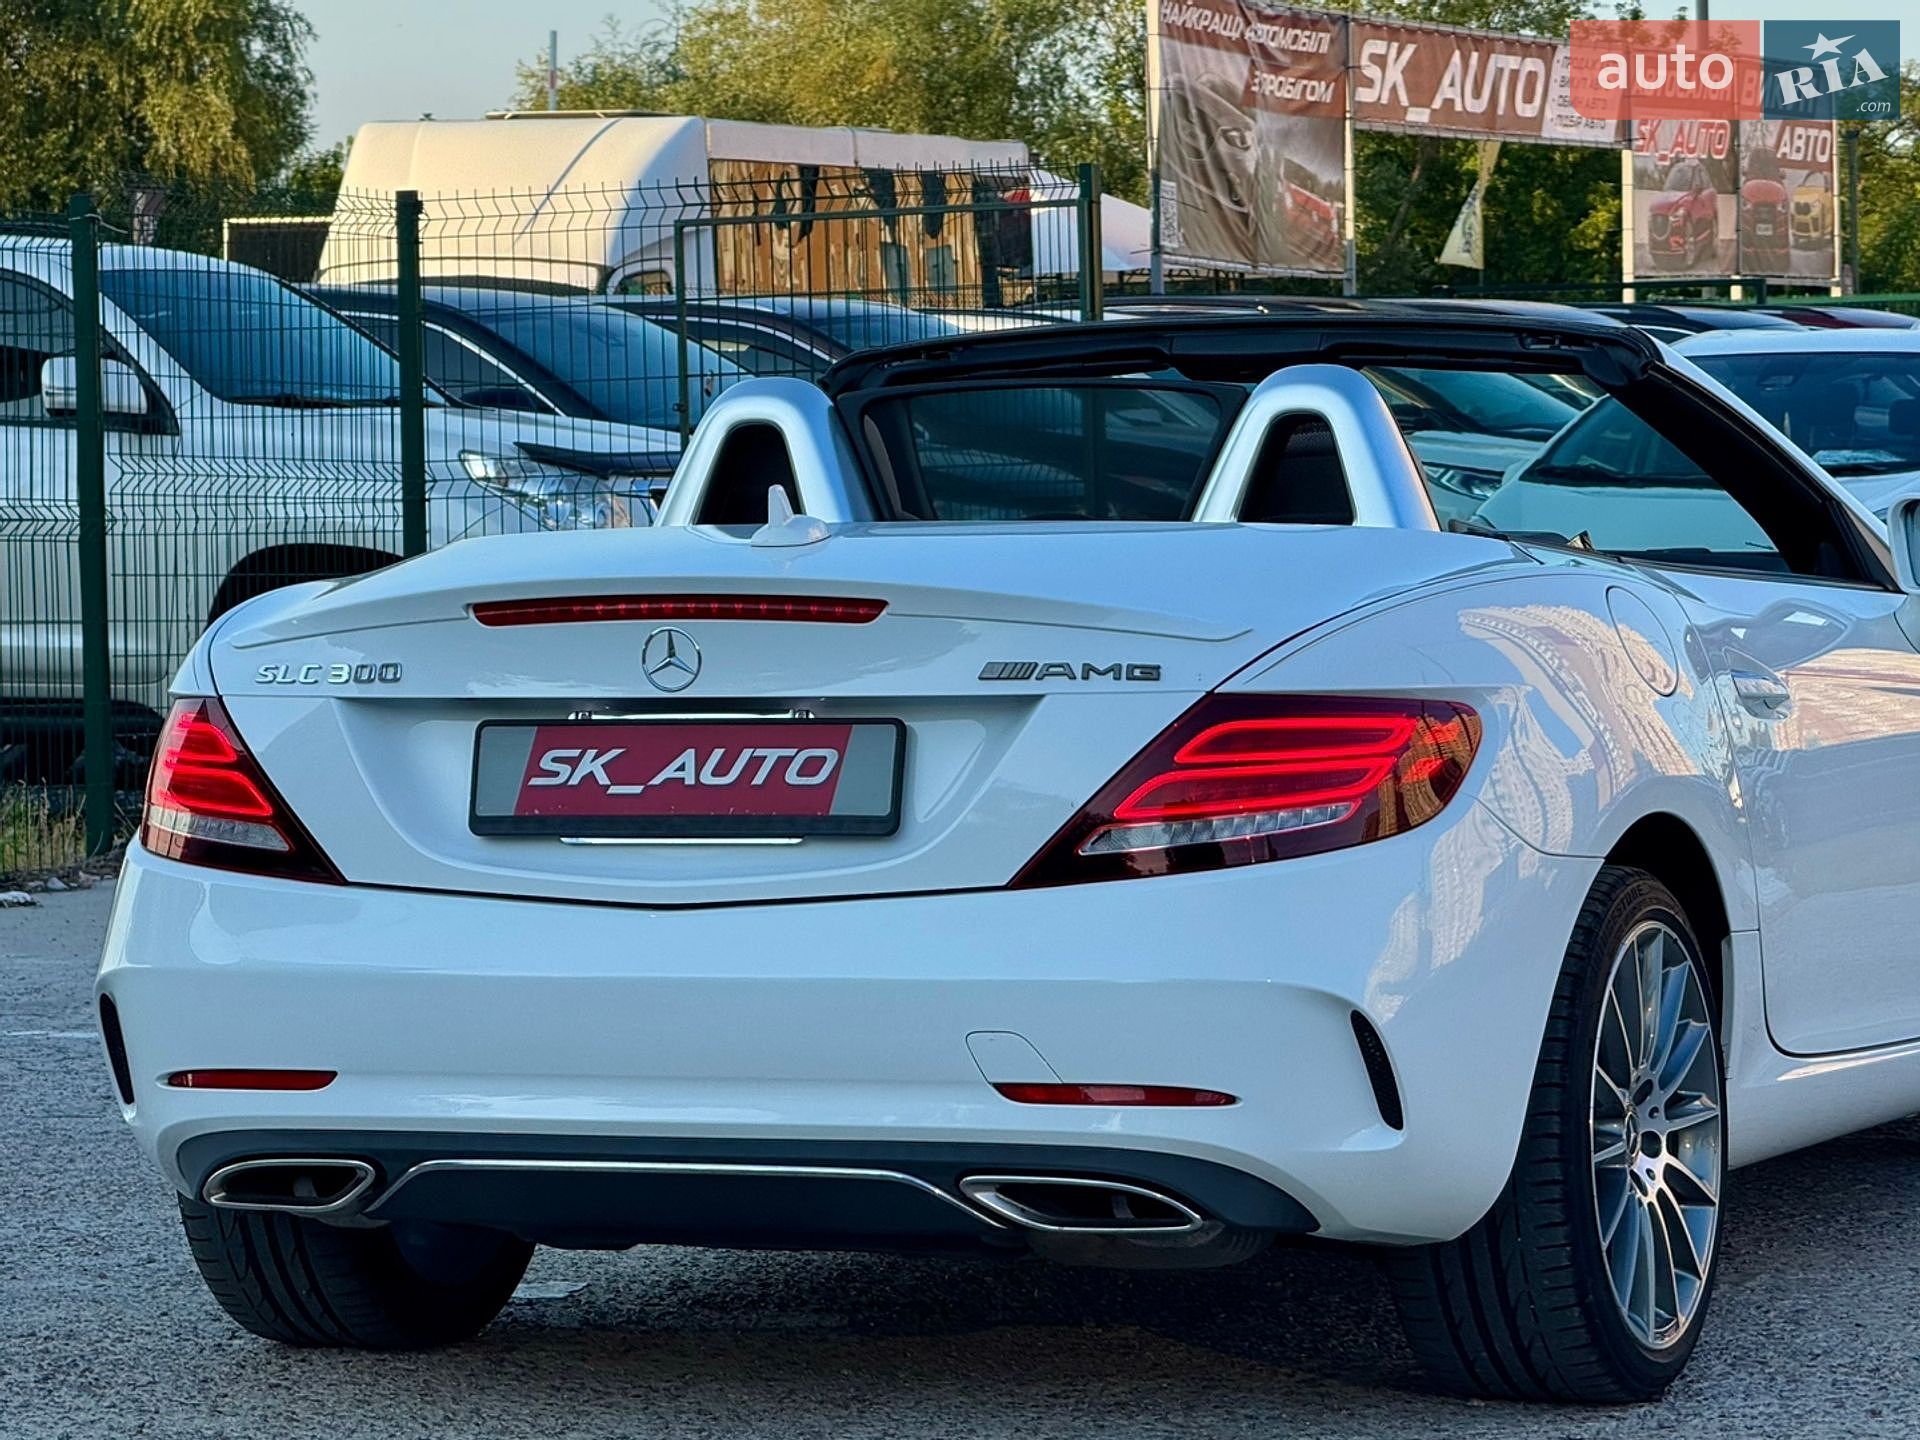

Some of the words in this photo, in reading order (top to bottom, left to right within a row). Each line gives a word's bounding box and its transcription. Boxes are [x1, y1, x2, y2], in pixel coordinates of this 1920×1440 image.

[1354, 38, 1546, 123] SK_AUTO
[1633, 116, 1731, 165] SK_AUTO
[1776, 126, 1832, 163] АВТО
[255, 664, 322, 684] SLC
[327, 663, 402, 684] 300
[1035, 662, 1162, 681] AMG
[527, 748, 839, 795] SK_AUTO
